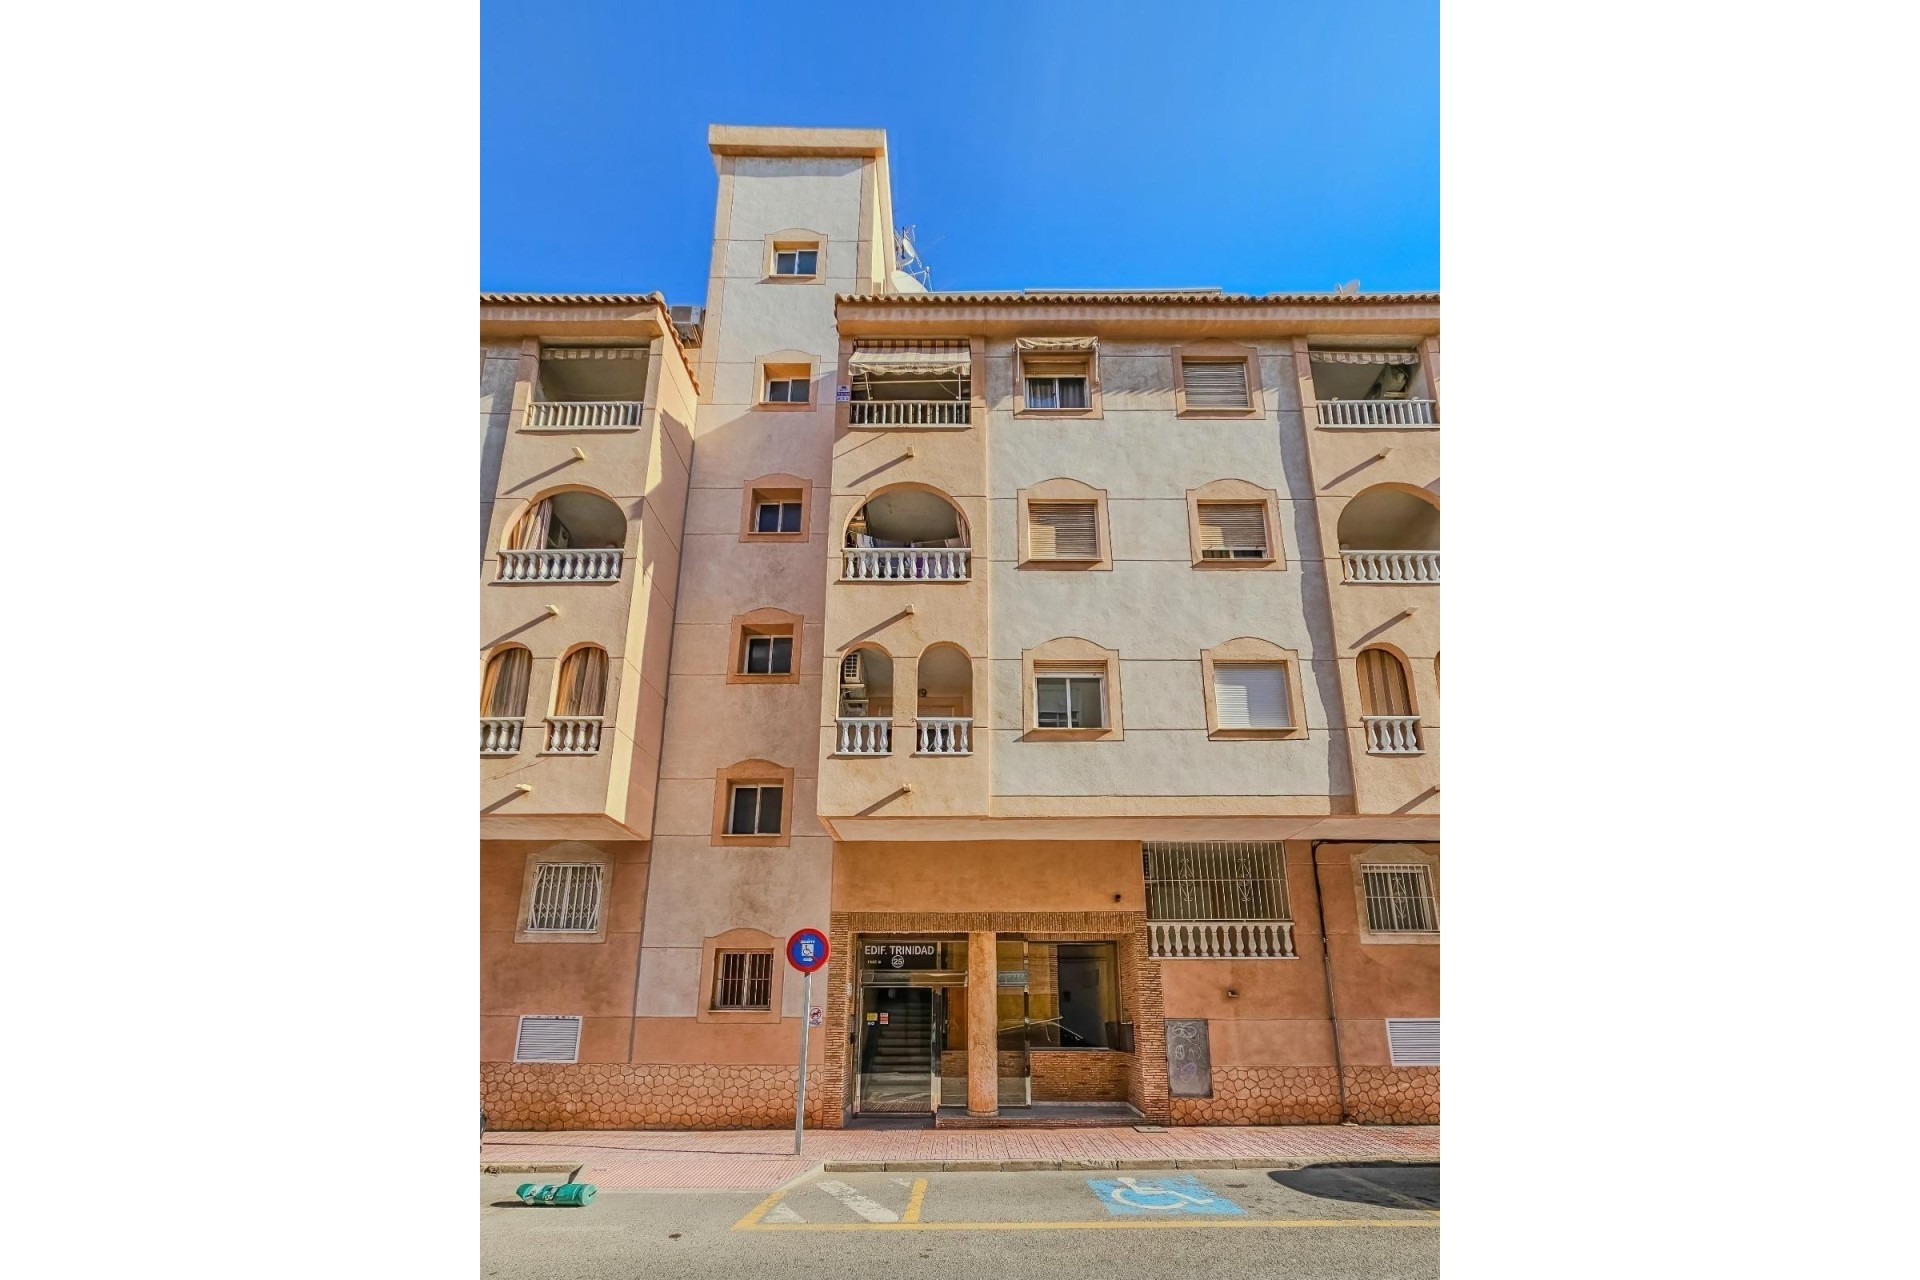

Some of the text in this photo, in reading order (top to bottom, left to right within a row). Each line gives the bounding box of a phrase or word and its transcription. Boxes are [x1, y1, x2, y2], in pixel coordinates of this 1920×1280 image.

[864, 945, 935, 955] EDIF. TRINIDAD
[893, 957, 903, 966] 25
